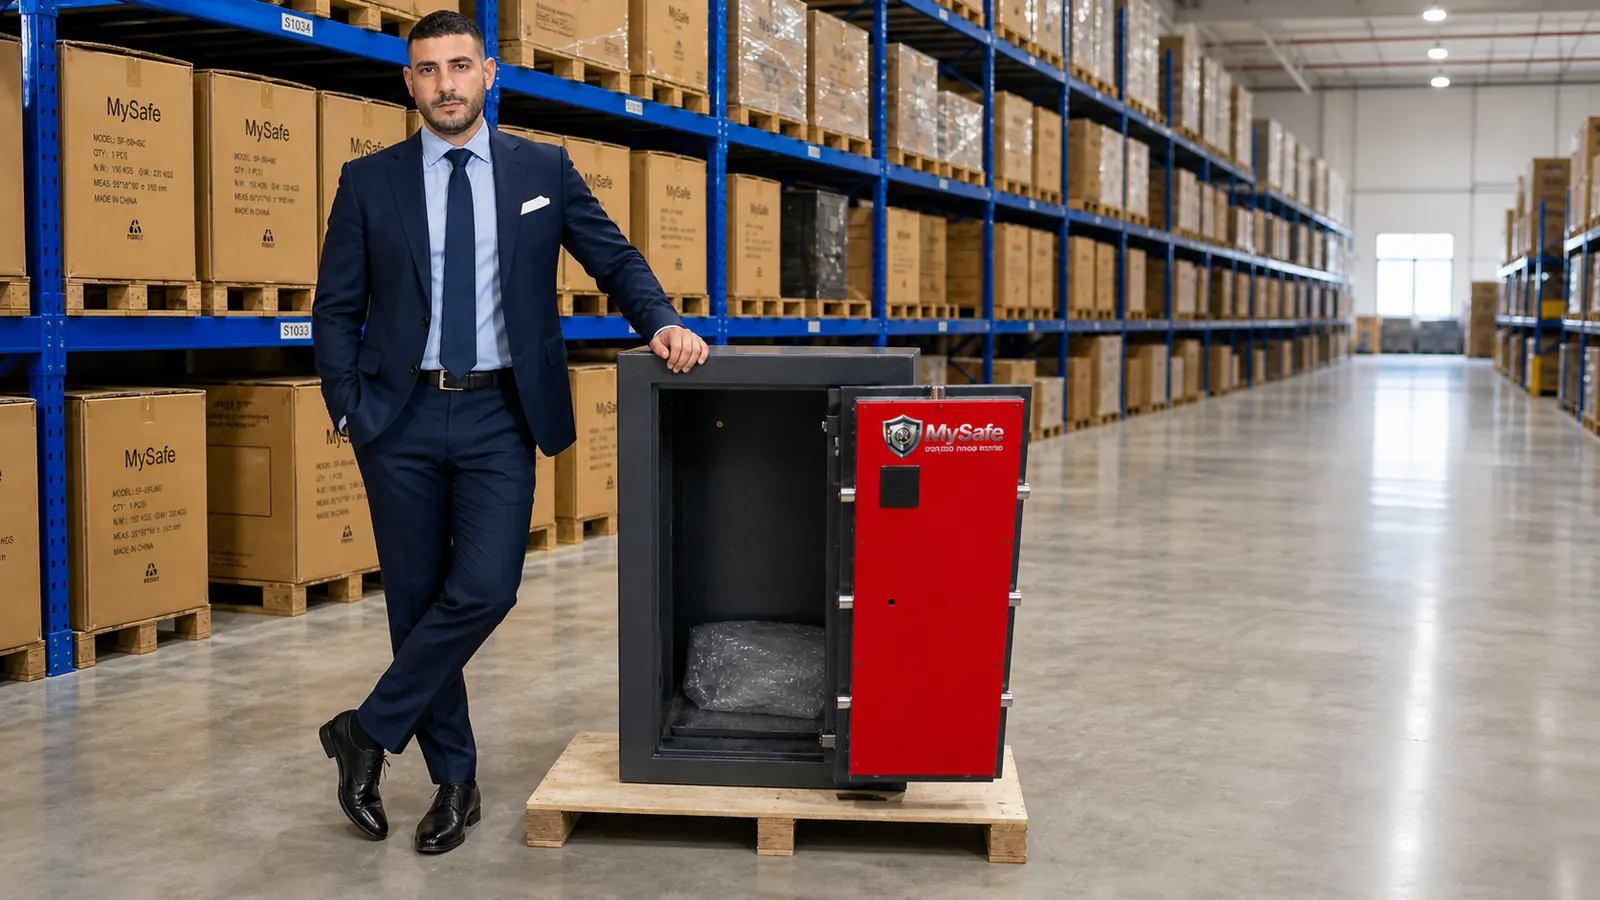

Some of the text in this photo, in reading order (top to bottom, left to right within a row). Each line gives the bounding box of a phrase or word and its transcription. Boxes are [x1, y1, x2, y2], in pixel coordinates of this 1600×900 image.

[285, 17, 311, 33] S1034
[107, 96, 161, 123] MySafe
[245, 118, 289, 142] MySafe
[94, 195, 137, 205] MADE IN CHINA
[283, 325, 309, 337] S1033
[924, 423, 1004, 445] MySafe
[125, 445, 176, 471] MySafe
